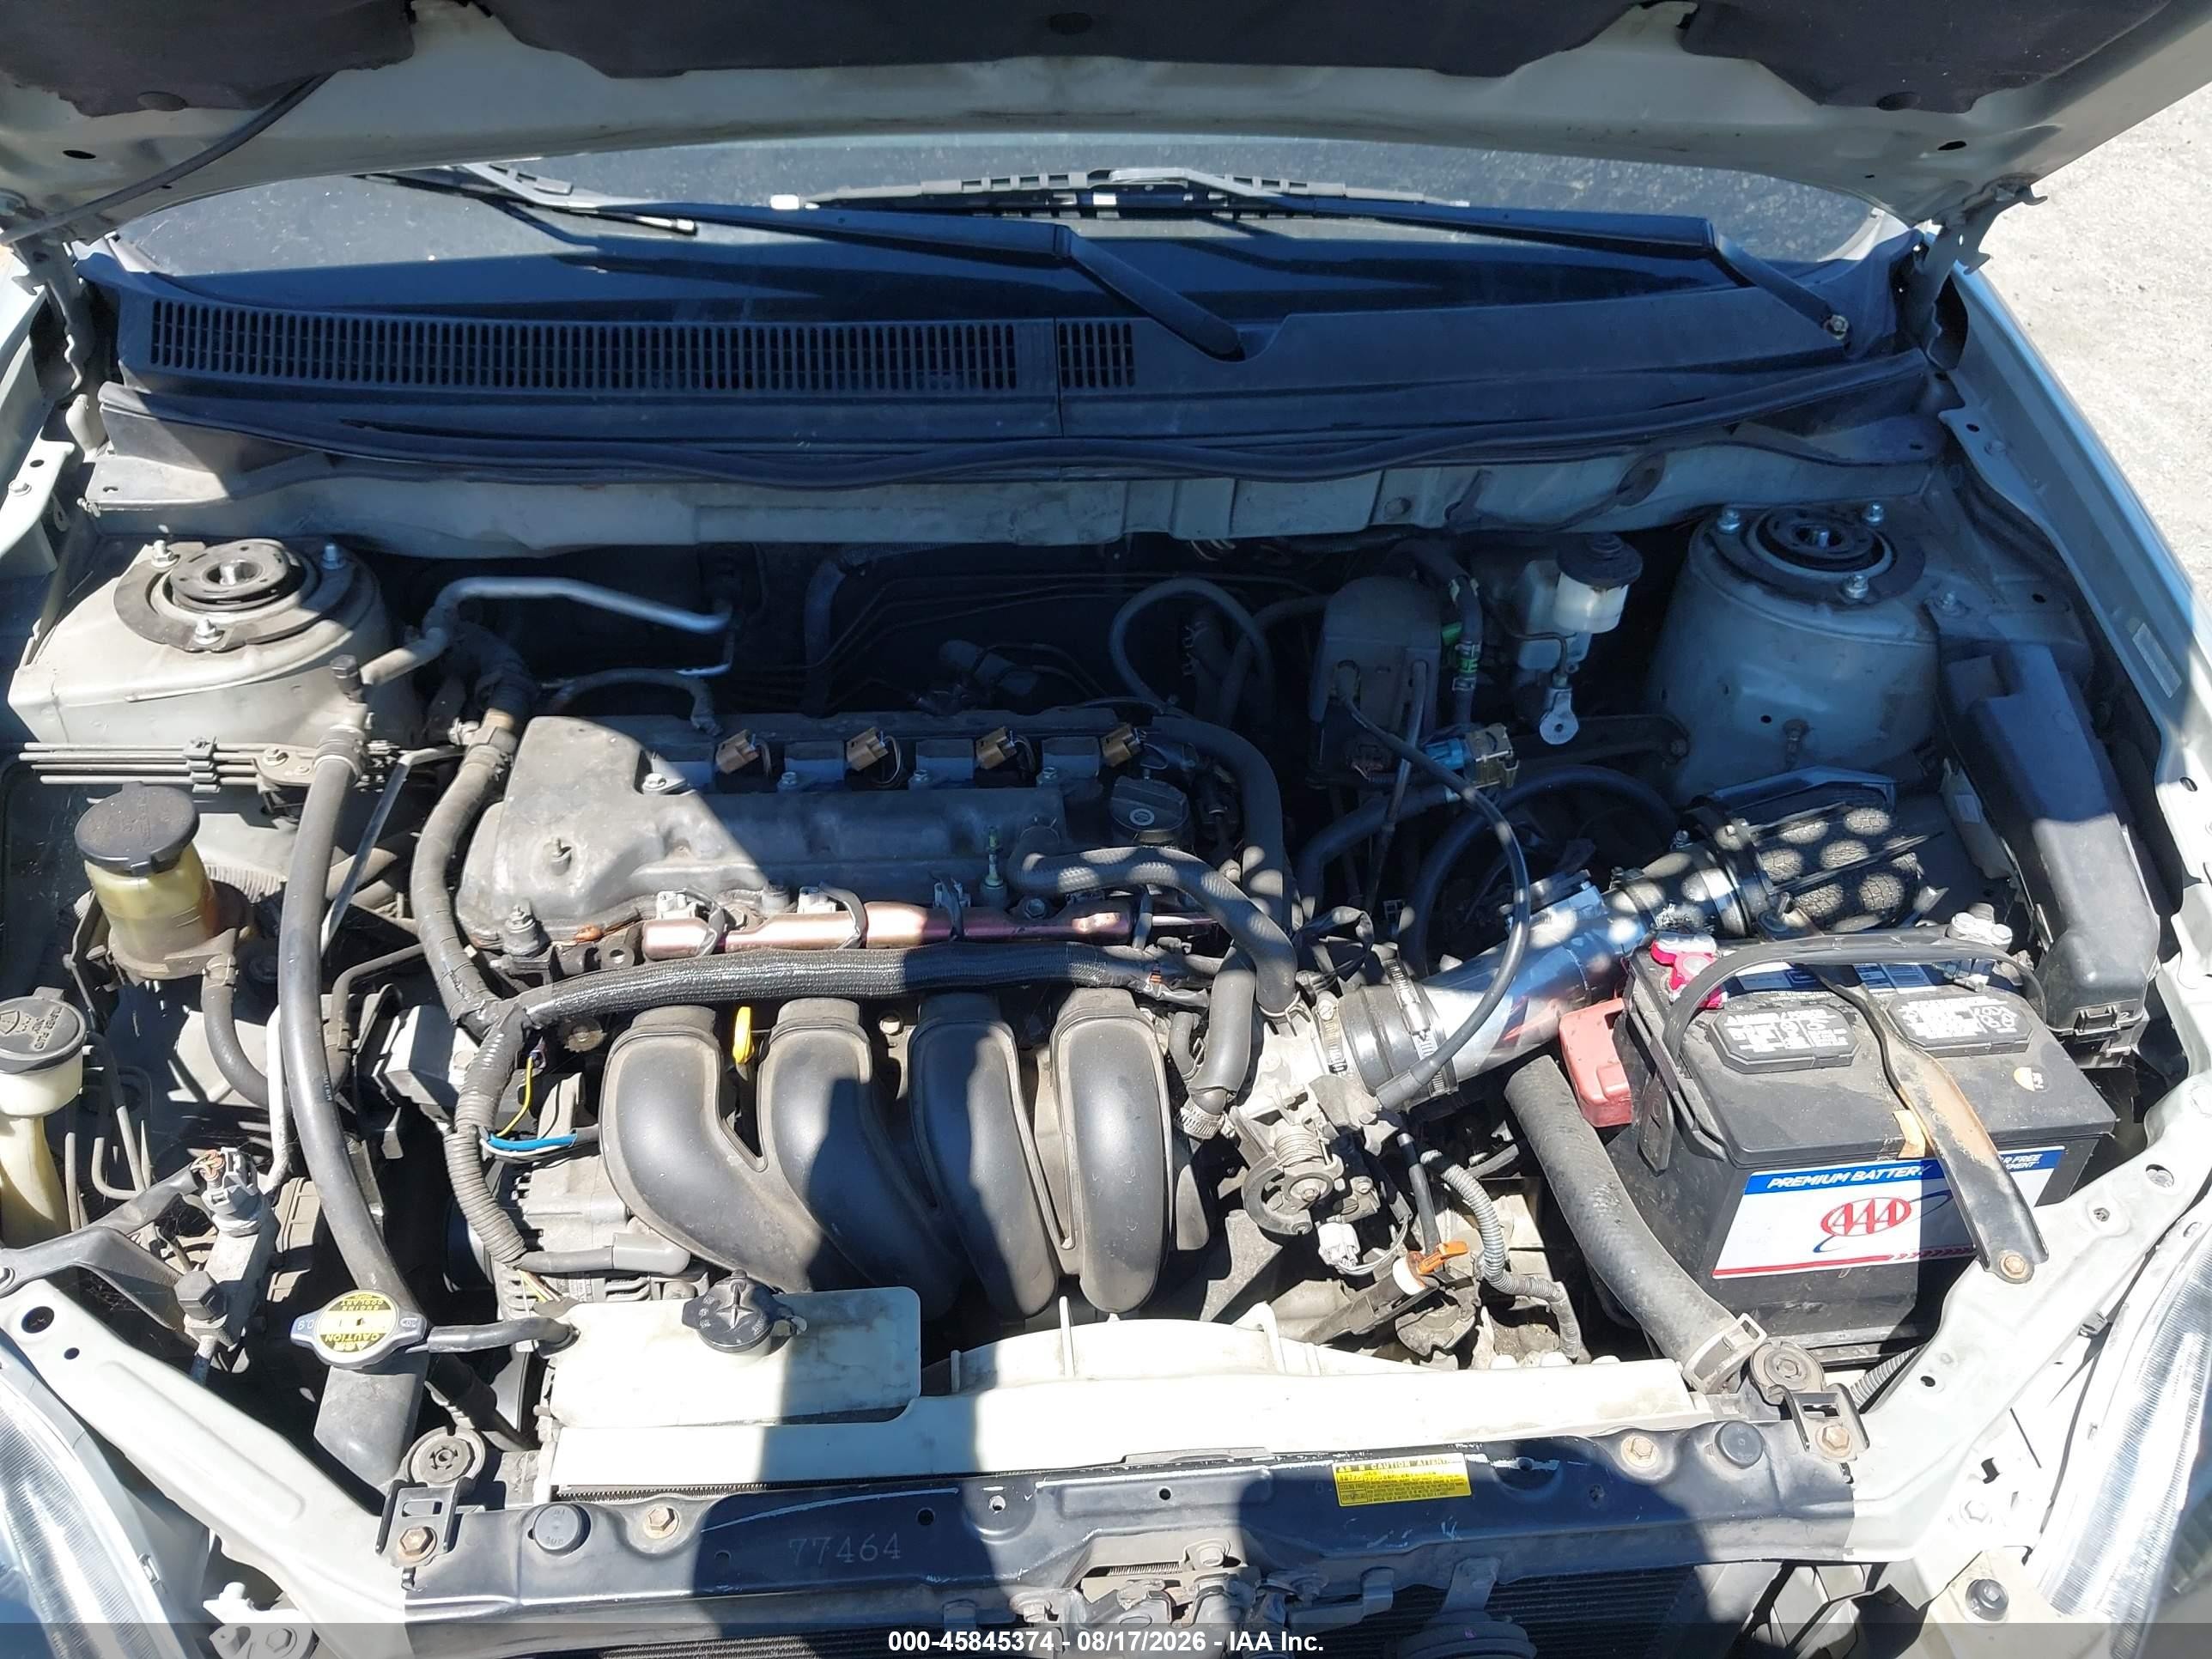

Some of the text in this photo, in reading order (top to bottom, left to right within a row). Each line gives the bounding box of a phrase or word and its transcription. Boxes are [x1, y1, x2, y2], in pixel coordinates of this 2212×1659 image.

[1766, 1164, 1933, 1189] PREMIUM BATTERY
[1826, 1197, 1910, 1236] AAA
[325, 1333, 380, 1343] CAUTION
[1370, 1461, 1412, 1471] CAUTION
[788, 1531, 902, 1566] 77464
